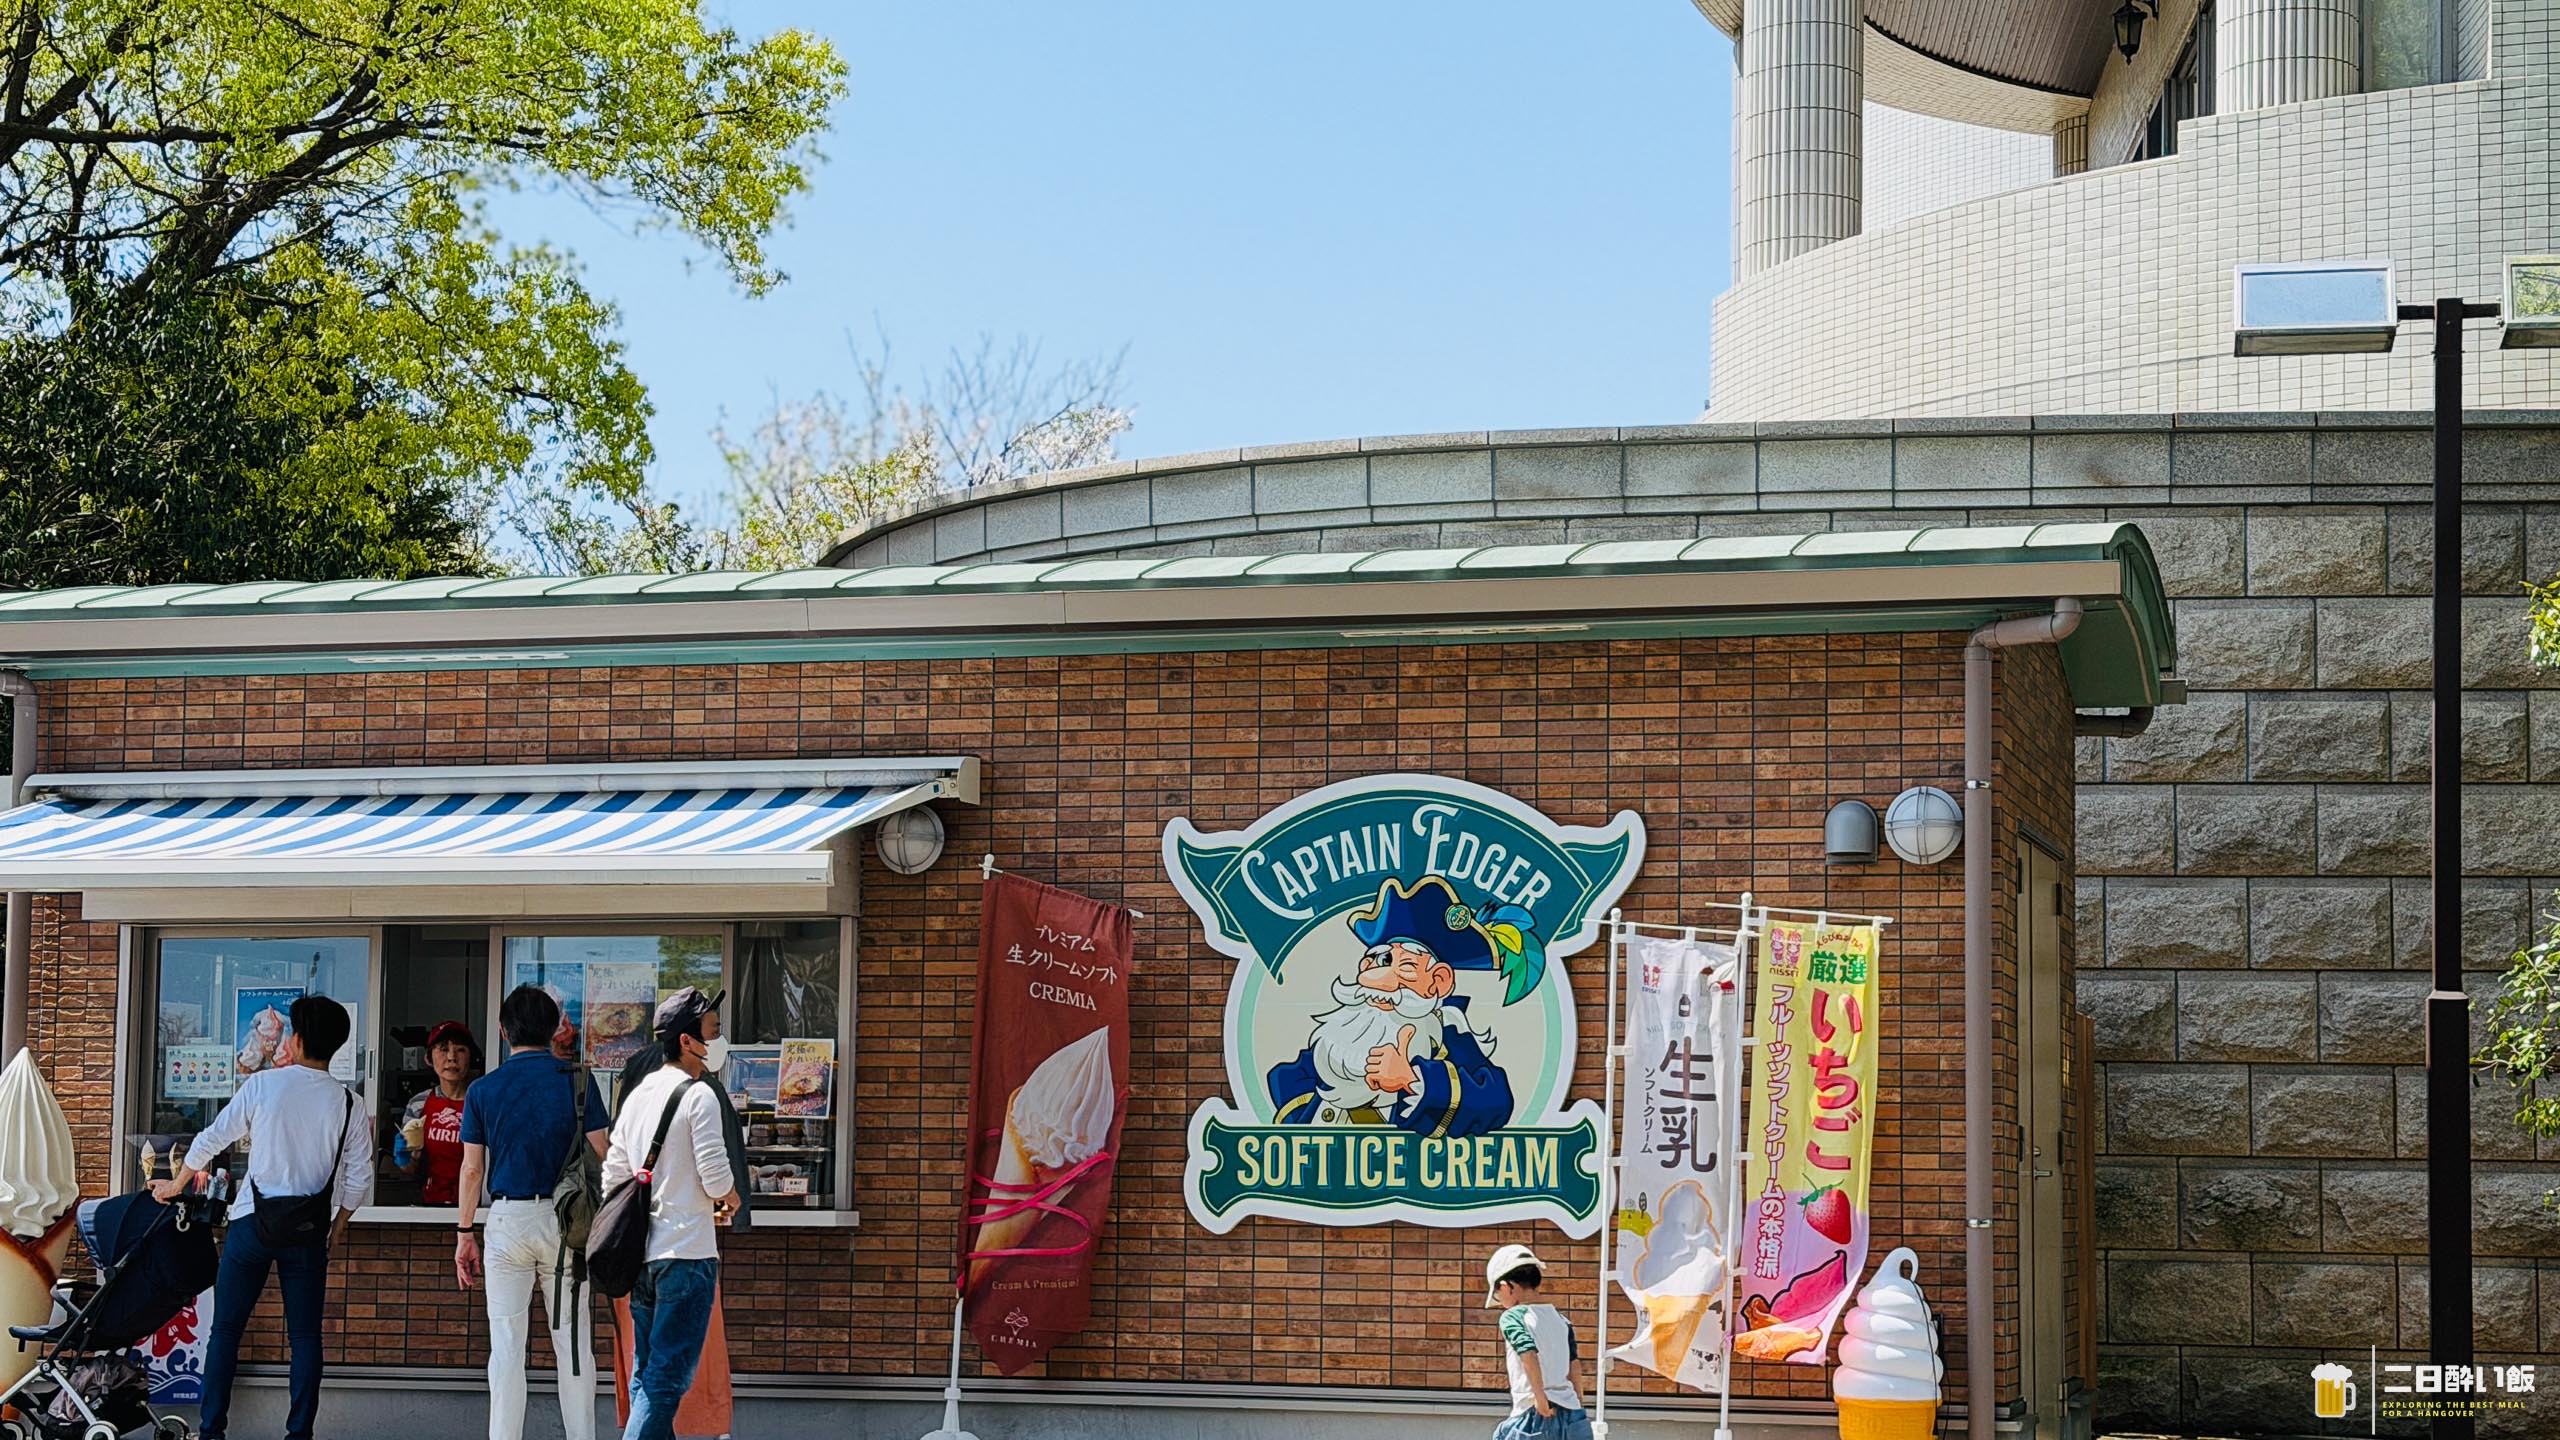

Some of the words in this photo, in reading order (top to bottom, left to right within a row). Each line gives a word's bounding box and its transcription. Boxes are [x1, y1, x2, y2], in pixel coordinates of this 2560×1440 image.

[1240, 822, 1400, 920] CAPTAIN
[1412, 803, 1552, 911] EDGER
[1005, 943, 1118, 985] 生クリームソフト
[1034, 925, 1096, 952] プレミアム
[1807, 950, 1867, 984] 厳選
[1029, 981, 1097, 1011] CREMIA
[1656, 1035, 1718, 1173] 生乳
[1805, 988, 1863, 1170] いちご
[1640, 1066, 1656, 1154] ソフトクリーム
[1754, 984, 1794, 1281] フルーツソフトクリームの本格派
[1237, 1135, 1334, 1187] SOFT
[1345, 1135, 1406, 1187] ICE
[1420, 1135, 1559, 1188] CREAM
[991, 1334, 1037, 1349] CREMIA
